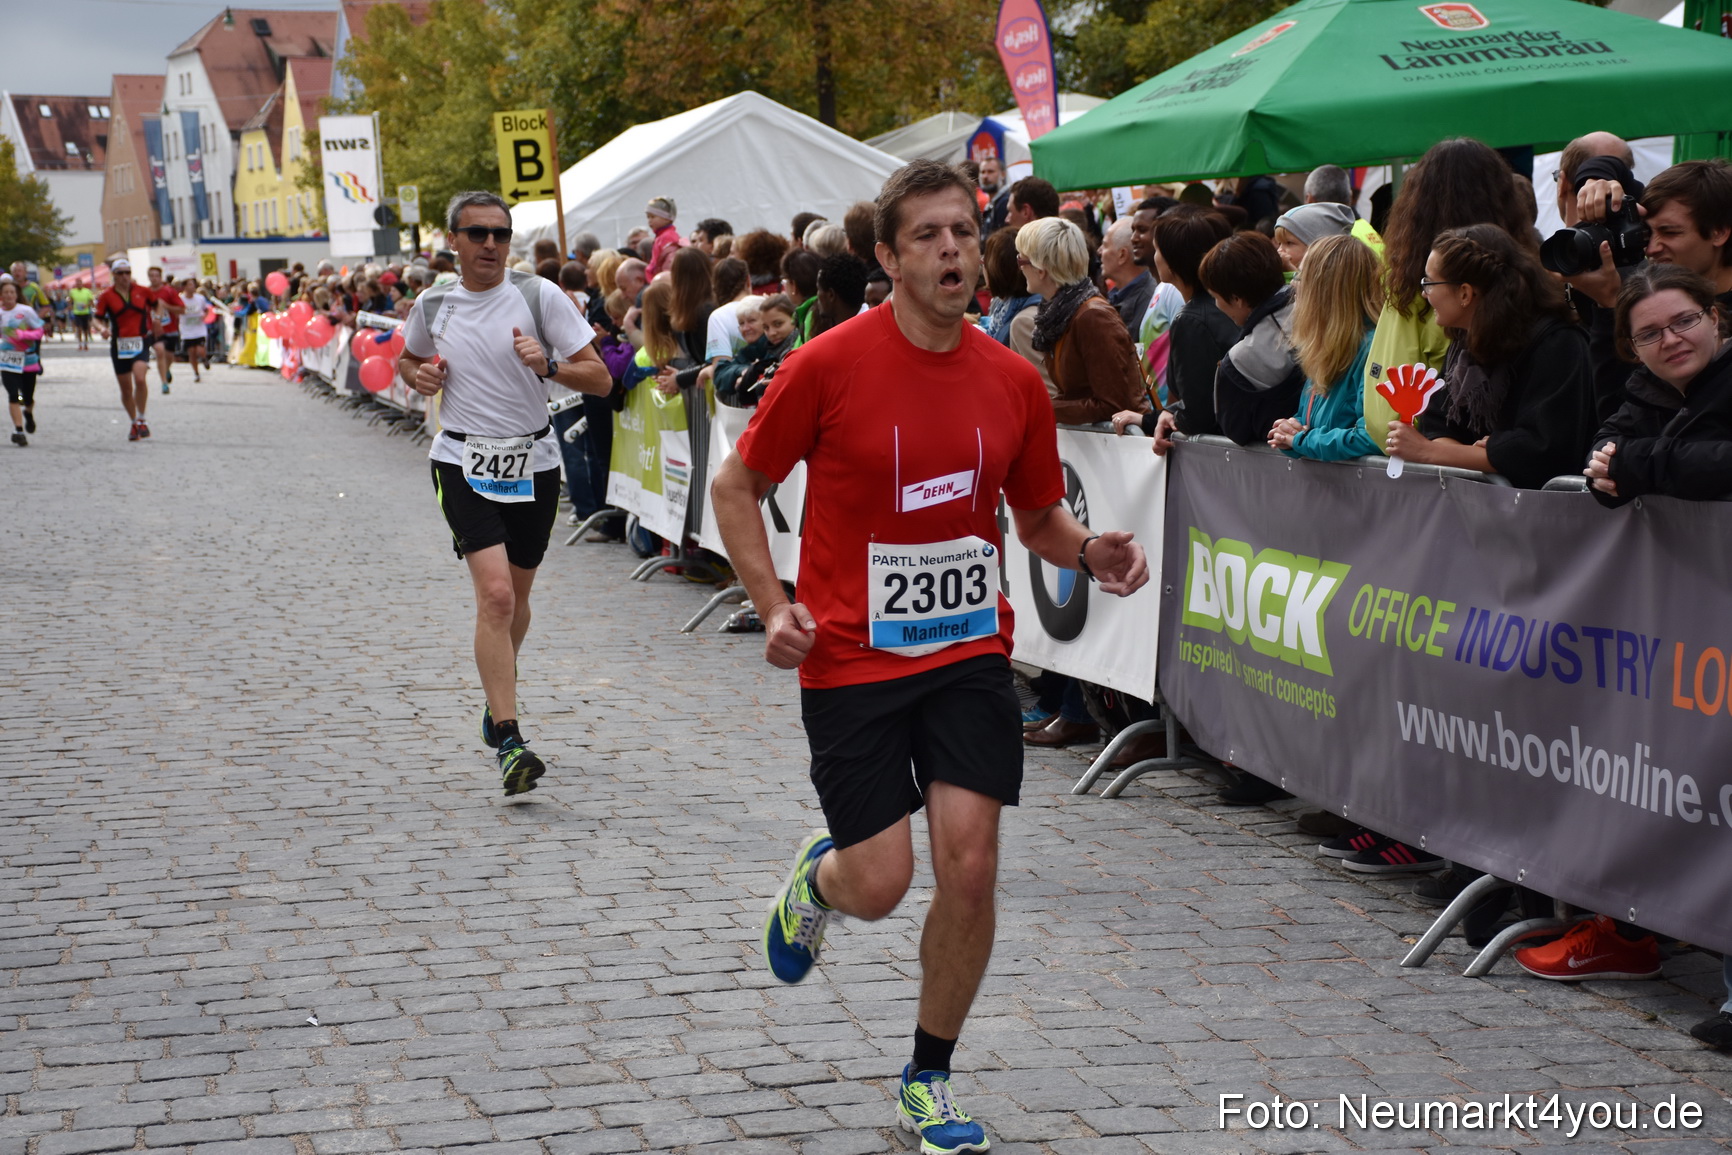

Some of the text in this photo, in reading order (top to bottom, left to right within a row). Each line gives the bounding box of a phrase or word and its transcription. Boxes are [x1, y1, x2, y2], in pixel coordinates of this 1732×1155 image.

[1399, 29, 1562, 53] Neumarkter
[1378, 39, 1615, 71] Lammsbräu
[1402, 57, 1631, 82] DAS FEINE ÖKOLOGISCHE BIER
[501, 113, 549, 132] Block
[513, 138, 544, 183] B
[204, 260, 214, 271] D
[471, 452, 529, 479] 2427
[480, 482, 519, 493] Renhard
[923, 481, 954, 500] DEHN
[872, 548, 978, 567] PARTL Neumarkt
[884, 563, 988, 615] 2303
[1188, 540, 1338, 658] BOCK
[902, 618, 969, 643] Manfred
[1348, 583, 1732, 719] OFFICE INDUSTRY LO
[1179, 632, 1234, 674] inspired
[1242, 663, 1274, 697] smart
[1276, 676, 1337, 720] concepts
